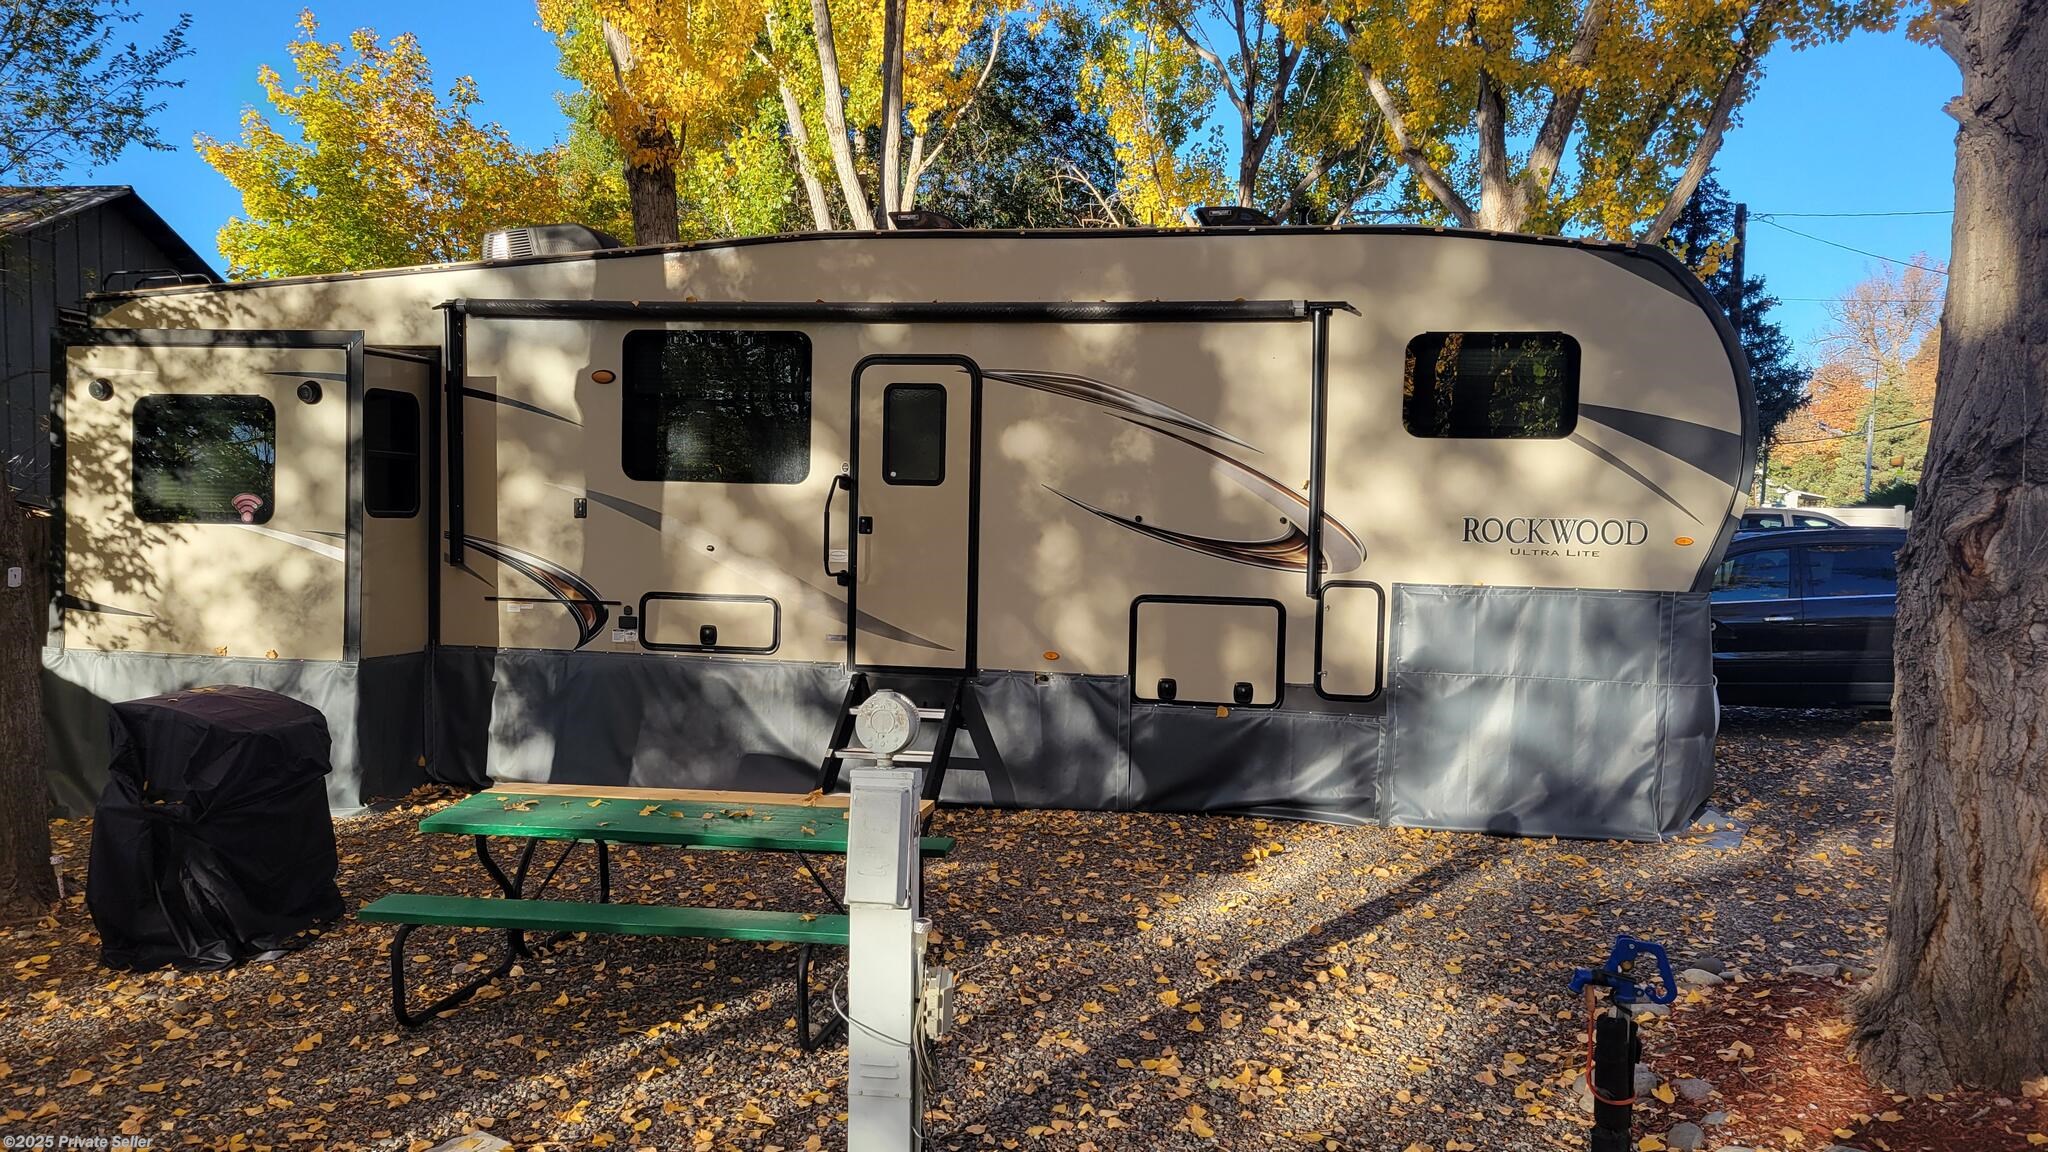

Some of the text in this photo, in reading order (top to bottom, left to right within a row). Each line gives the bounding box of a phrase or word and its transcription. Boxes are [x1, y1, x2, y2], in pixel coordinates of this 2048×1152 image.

[1462, 517, 1649, 546] ROCKWOOD
[1510, 548, 1600, 558] ULTRA LITE
